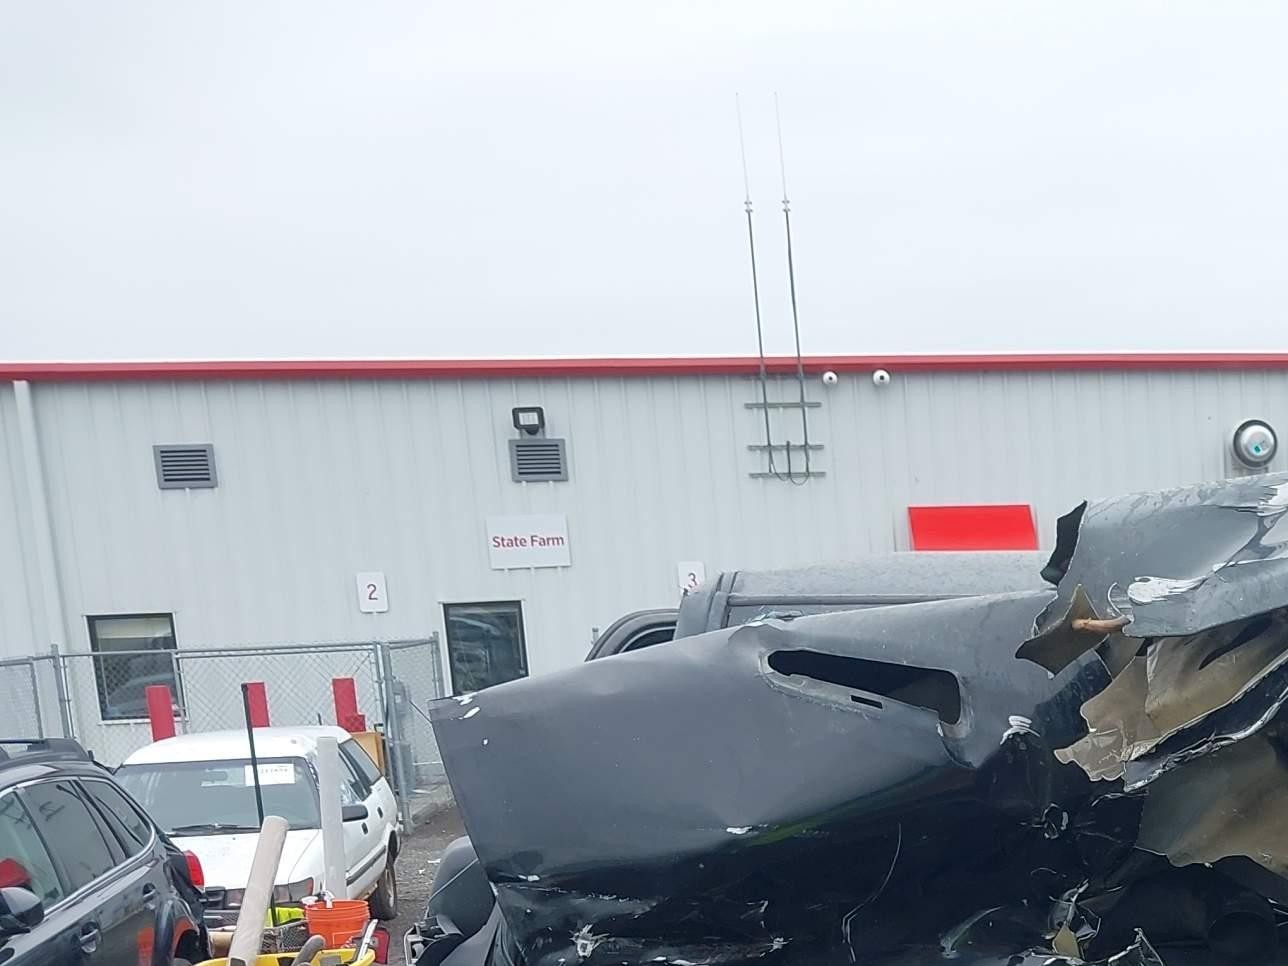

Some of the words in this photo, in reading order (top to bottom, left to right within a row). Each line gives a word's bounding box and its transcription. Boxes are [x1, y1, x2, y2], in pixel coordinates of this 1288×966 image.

[492, 535, 527, 548] State
[530, 535, 565, 547] Farm
[688, 572, 697, 588] 3
[367, 583, 379, 600] 2
